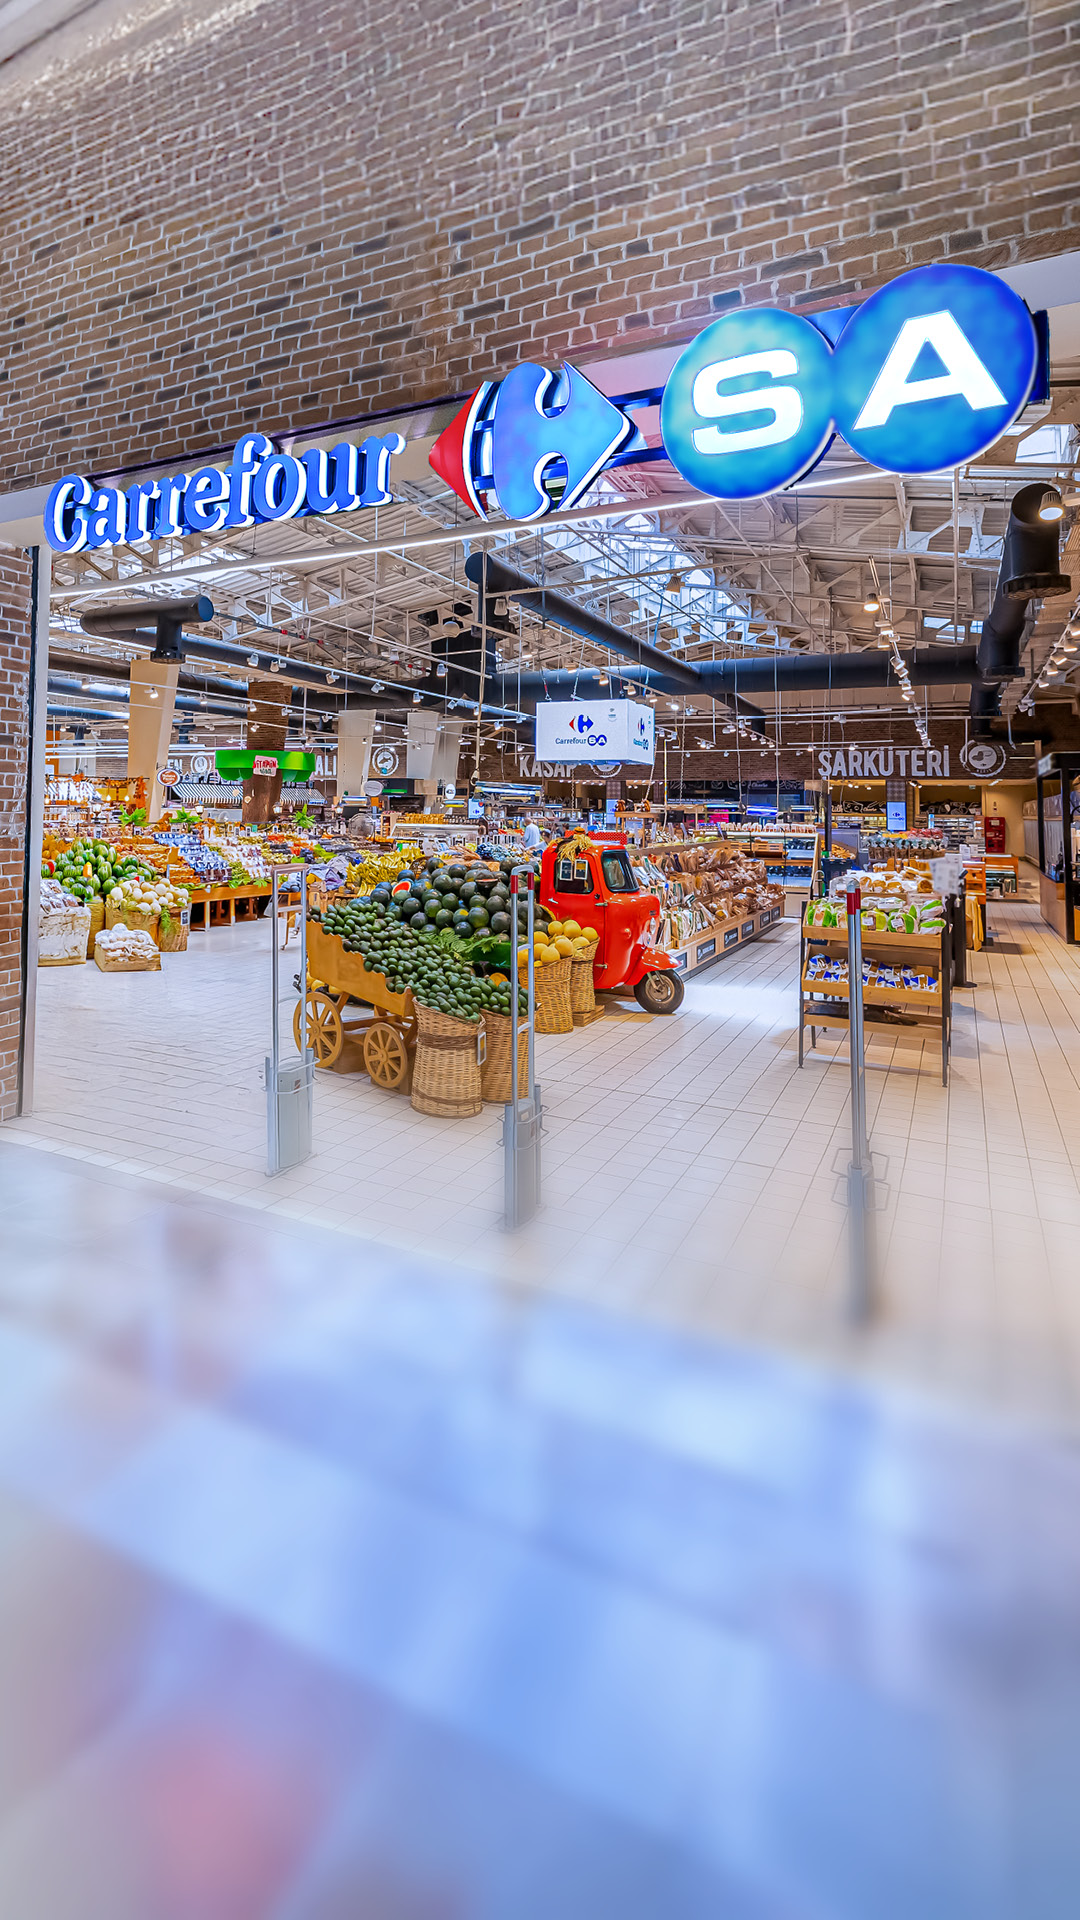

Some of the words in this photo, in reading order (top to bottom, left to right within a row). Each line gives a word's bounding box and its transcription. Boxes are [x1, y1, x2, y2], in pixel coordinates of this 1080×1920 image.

[43, 432, 406, 553] Carrefour
[555, 737, 587, 745] Carrefour
[314, 755, 337, 776] ALI
[818, 745, 950, 780] ŞARKÜTERİ
